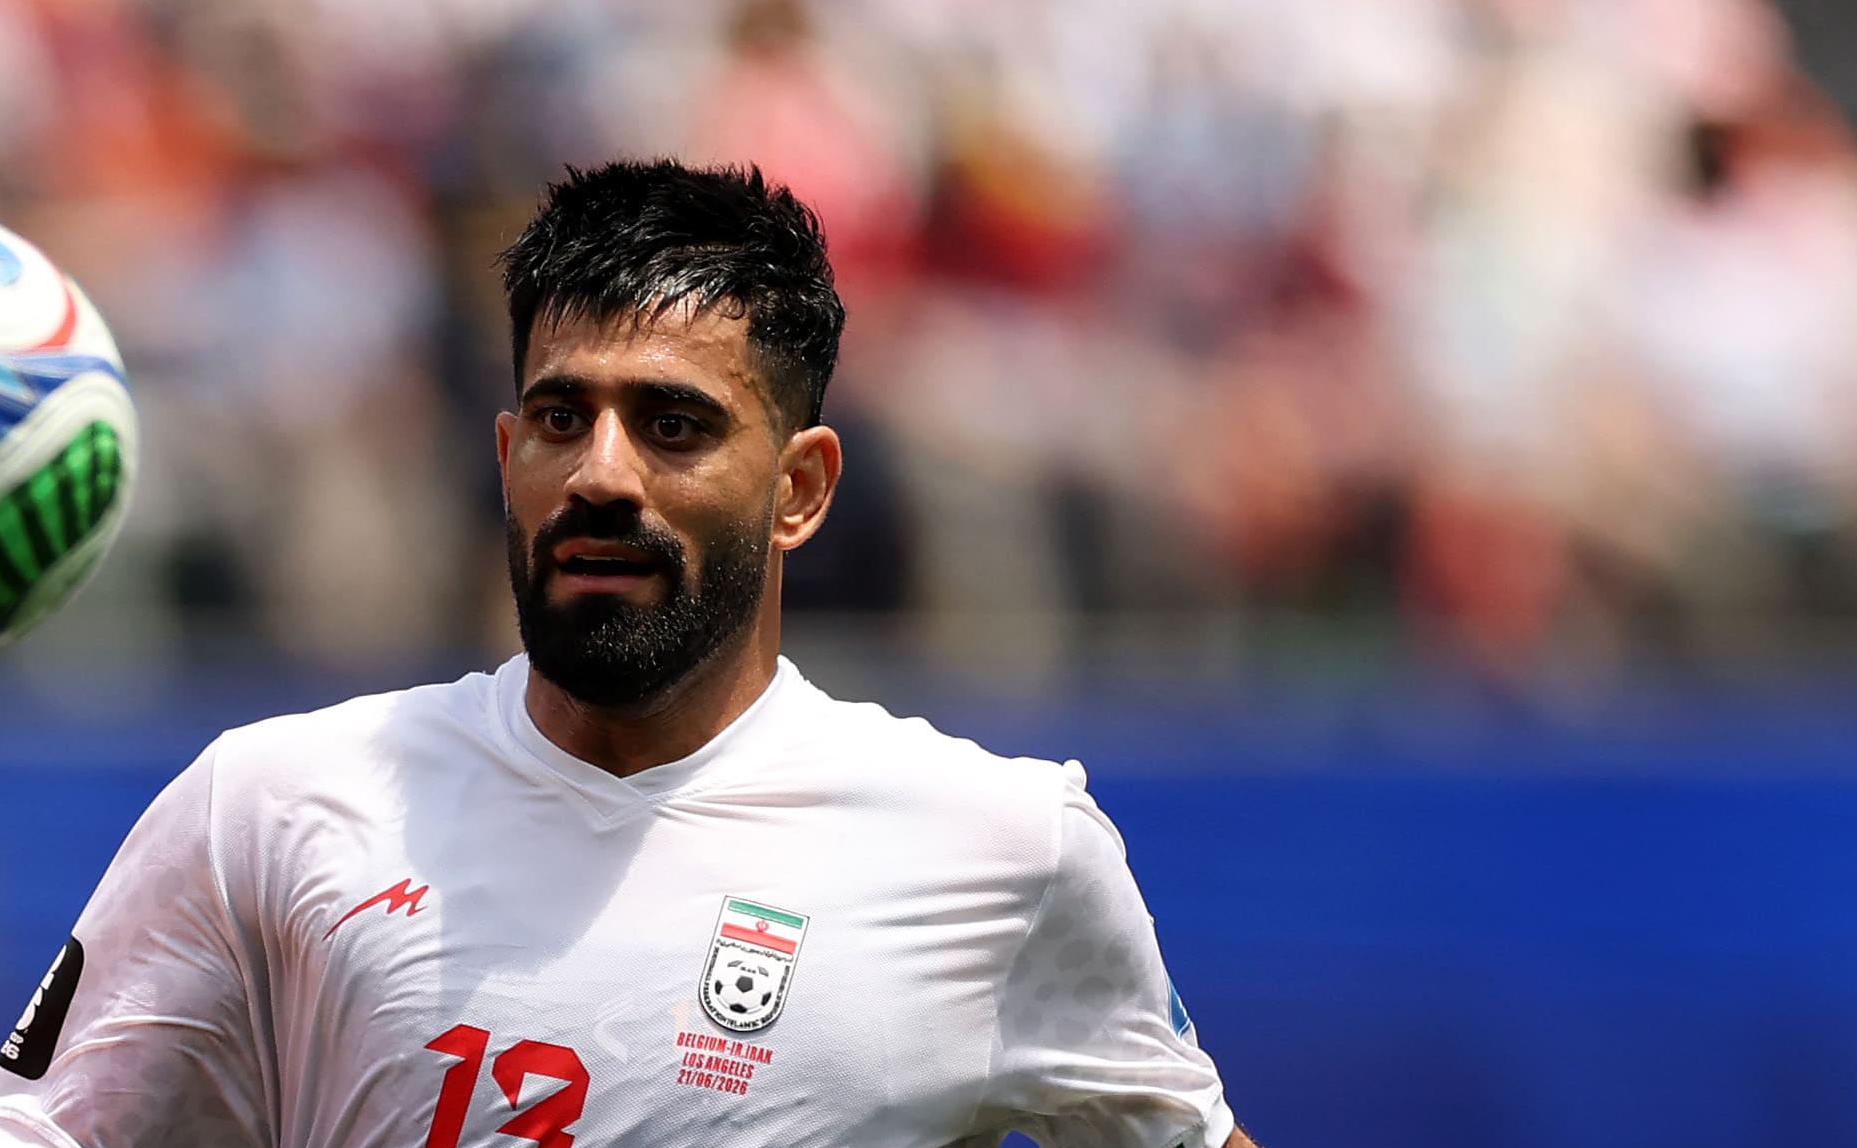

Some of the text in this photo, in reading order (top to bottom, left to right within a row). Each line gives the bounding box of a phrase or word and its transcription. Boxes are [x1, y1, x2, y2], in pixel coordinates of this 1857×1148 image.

[683, 1051, 755, 1080] LOS ANGELES
[677, 1068, 749, 1096] 21/06/2026
